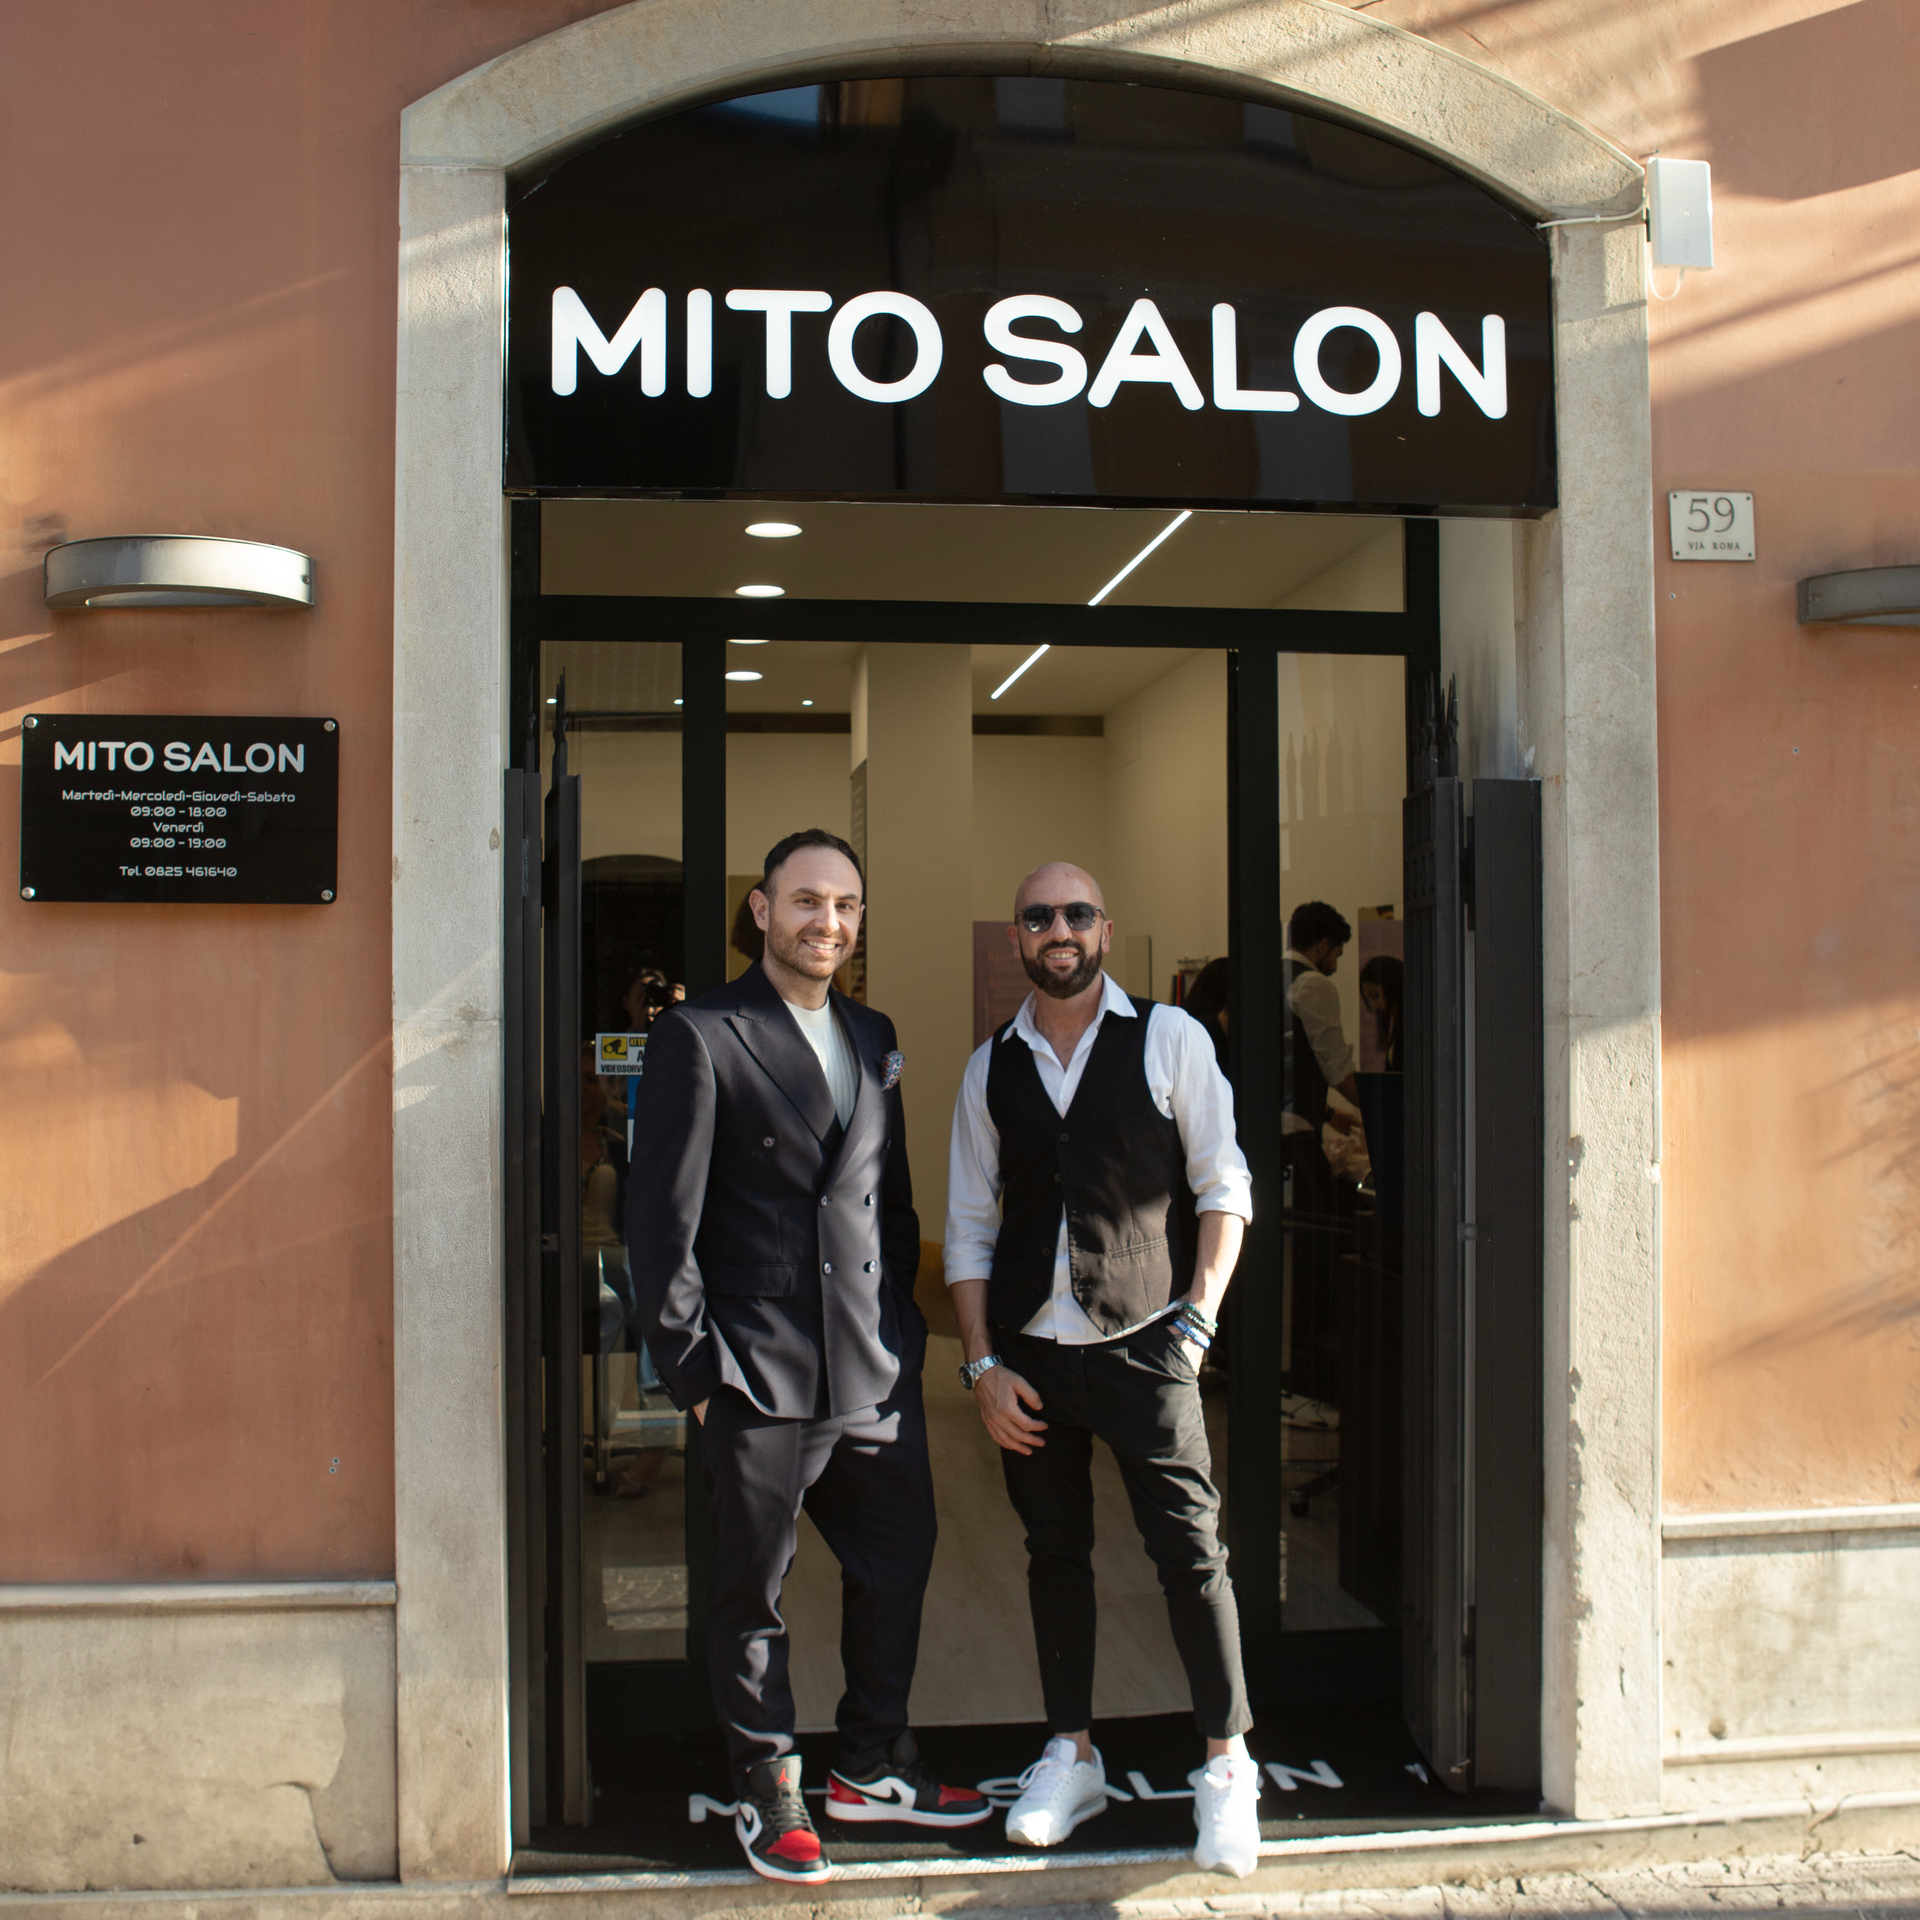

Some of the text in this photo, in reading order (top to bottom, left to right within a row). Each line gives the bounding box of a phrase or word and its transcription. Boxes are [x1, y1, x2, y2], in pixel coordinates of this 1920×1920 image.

[551, 286, 1509, 420] MITO SALON
[1687, 496, 1736, 533] 59
[1688, 541, 1741, 551] VIA ROMA
[54, 741, 305, 773] MITO SALON
[130, 806, 176, 818] 09:00
[188, 806, 227, 818] 18:00
[152, 821, 204, 833] Venerdì
[130, 837, 176, 849] 09:00
[188, 837, 227, 849] 19:00
[119, 865, 238, 877] Tel. 0825 461640
[601, 1064, 643, 1073] VIDEOSORV
